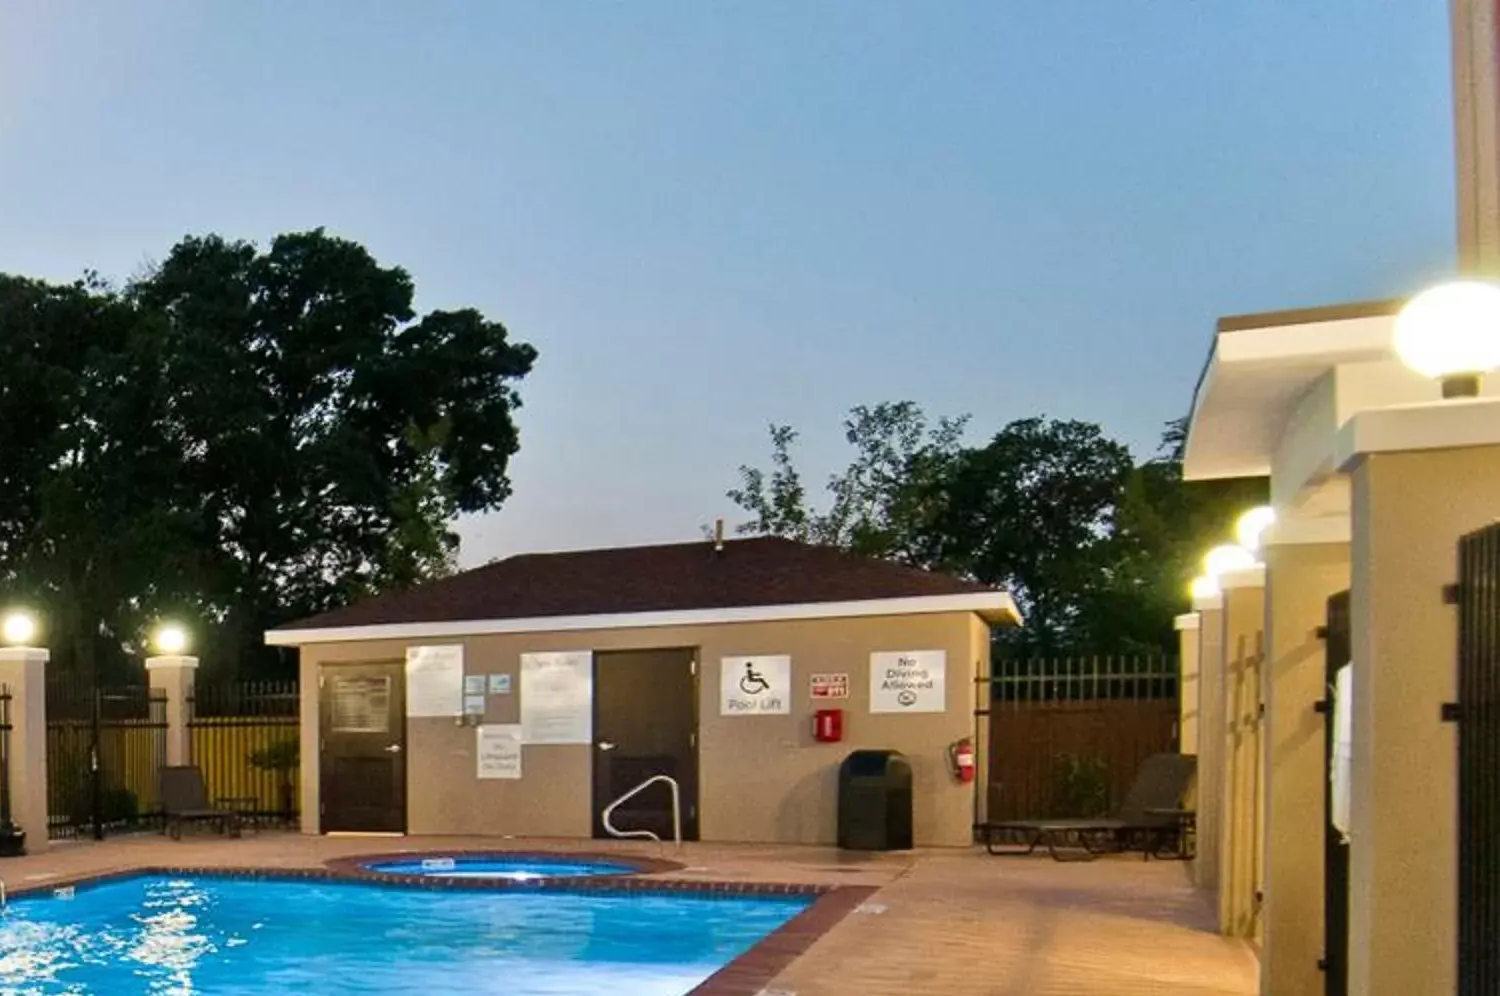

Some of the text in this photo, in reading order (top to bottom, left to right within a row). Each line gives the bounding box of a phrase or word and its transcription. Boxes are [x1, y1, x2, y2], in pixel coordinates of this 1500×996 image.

[898, 657, 917, 667] No
[885, 668, 929, 680] Diving
[881, 680, 934, 690] Allowed
[728, 698, 782, 710] Pool Lift
